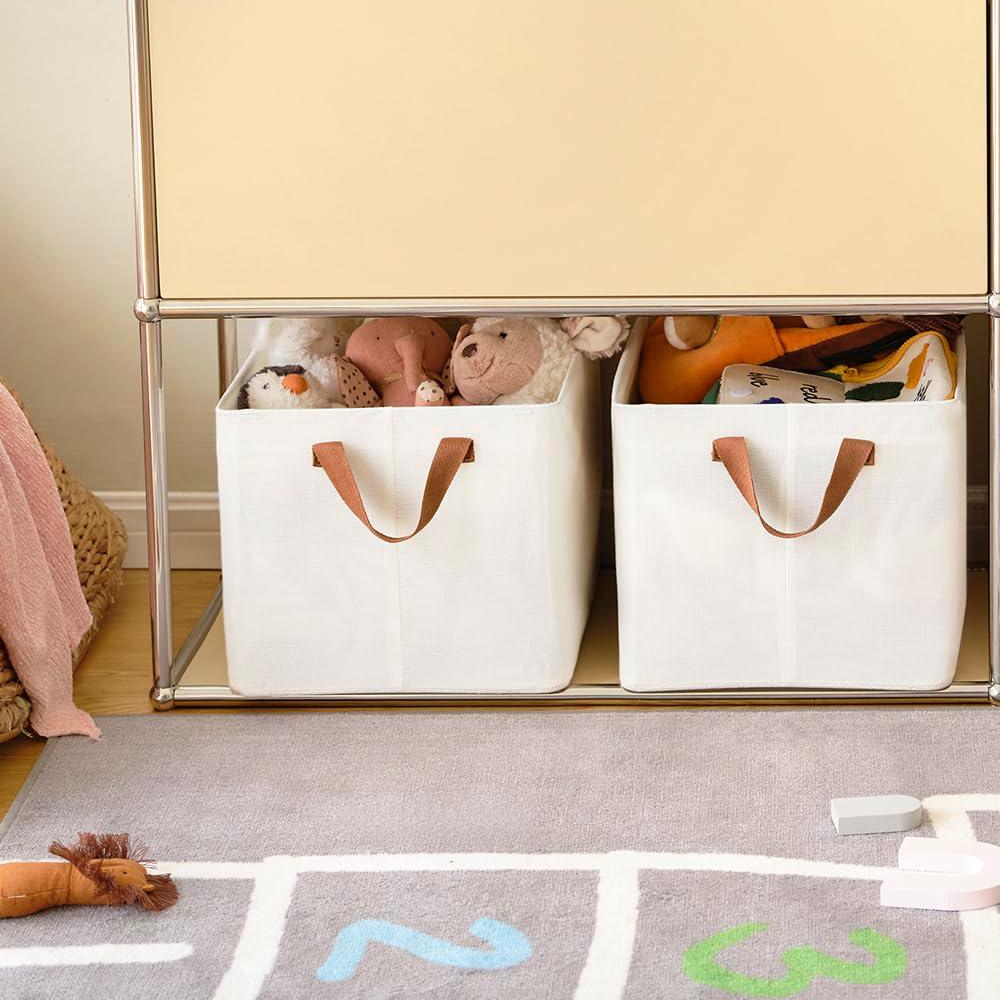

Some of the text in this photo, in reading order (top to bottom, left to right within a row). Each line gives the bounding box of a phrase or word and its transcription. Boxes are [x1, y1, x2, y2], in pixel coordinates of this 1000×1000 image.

[799, 383, 832, 403] red
[316, 918, 534, 982] 2
[682, 922, 908, 997] 3
